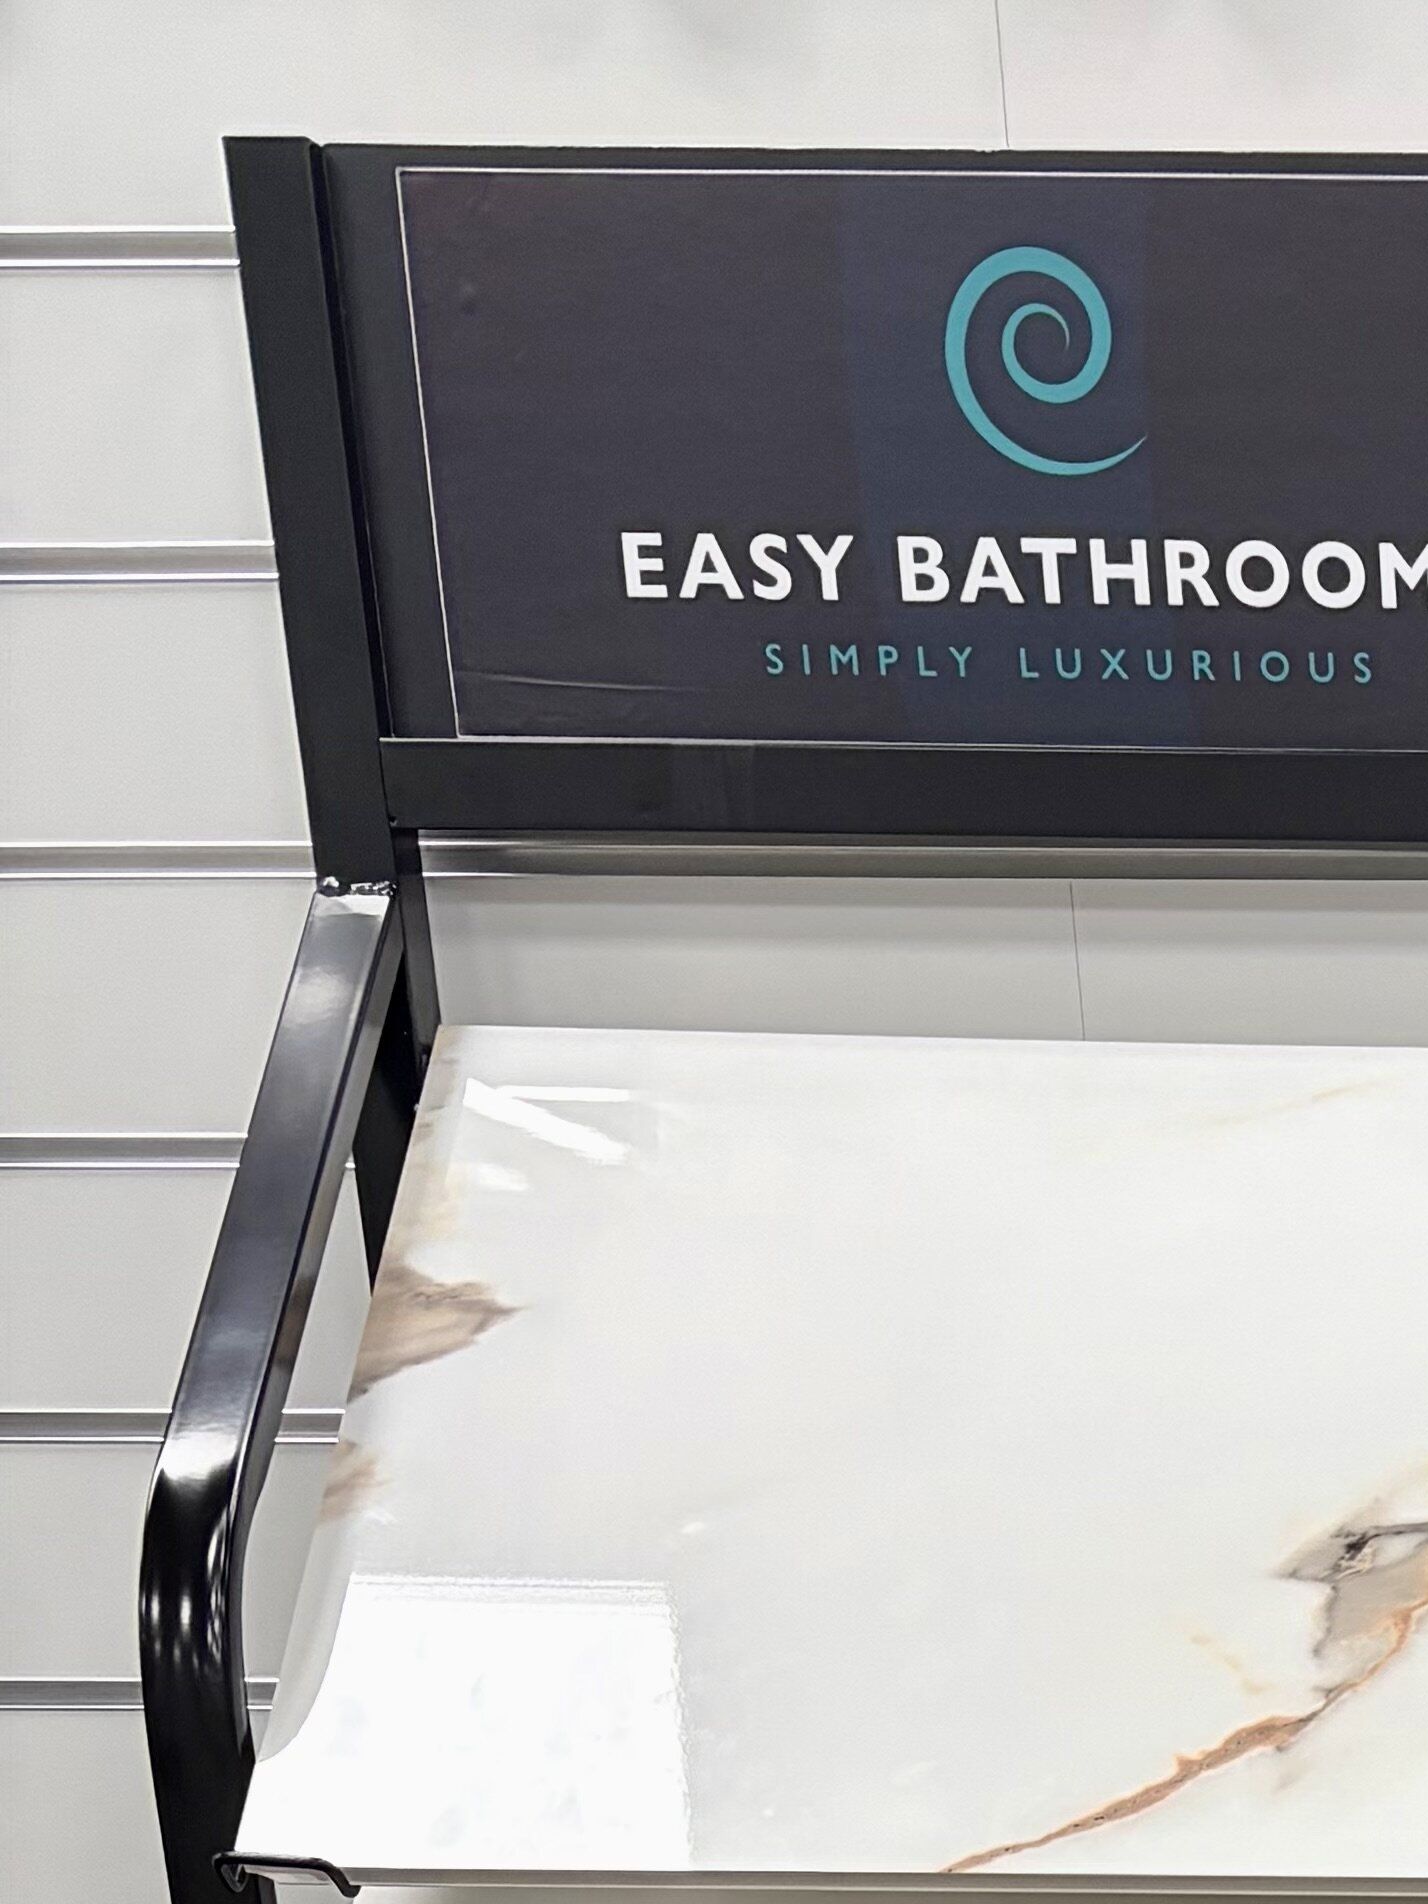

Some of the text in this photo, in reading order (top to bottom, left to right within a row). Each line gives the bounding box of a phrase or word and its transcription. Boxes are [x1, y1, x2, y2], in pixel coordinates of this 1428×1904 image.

[622, 532, 853, 600] EASY
[766, 644, 1371, 683] SIMPLY LUXURIOUS
